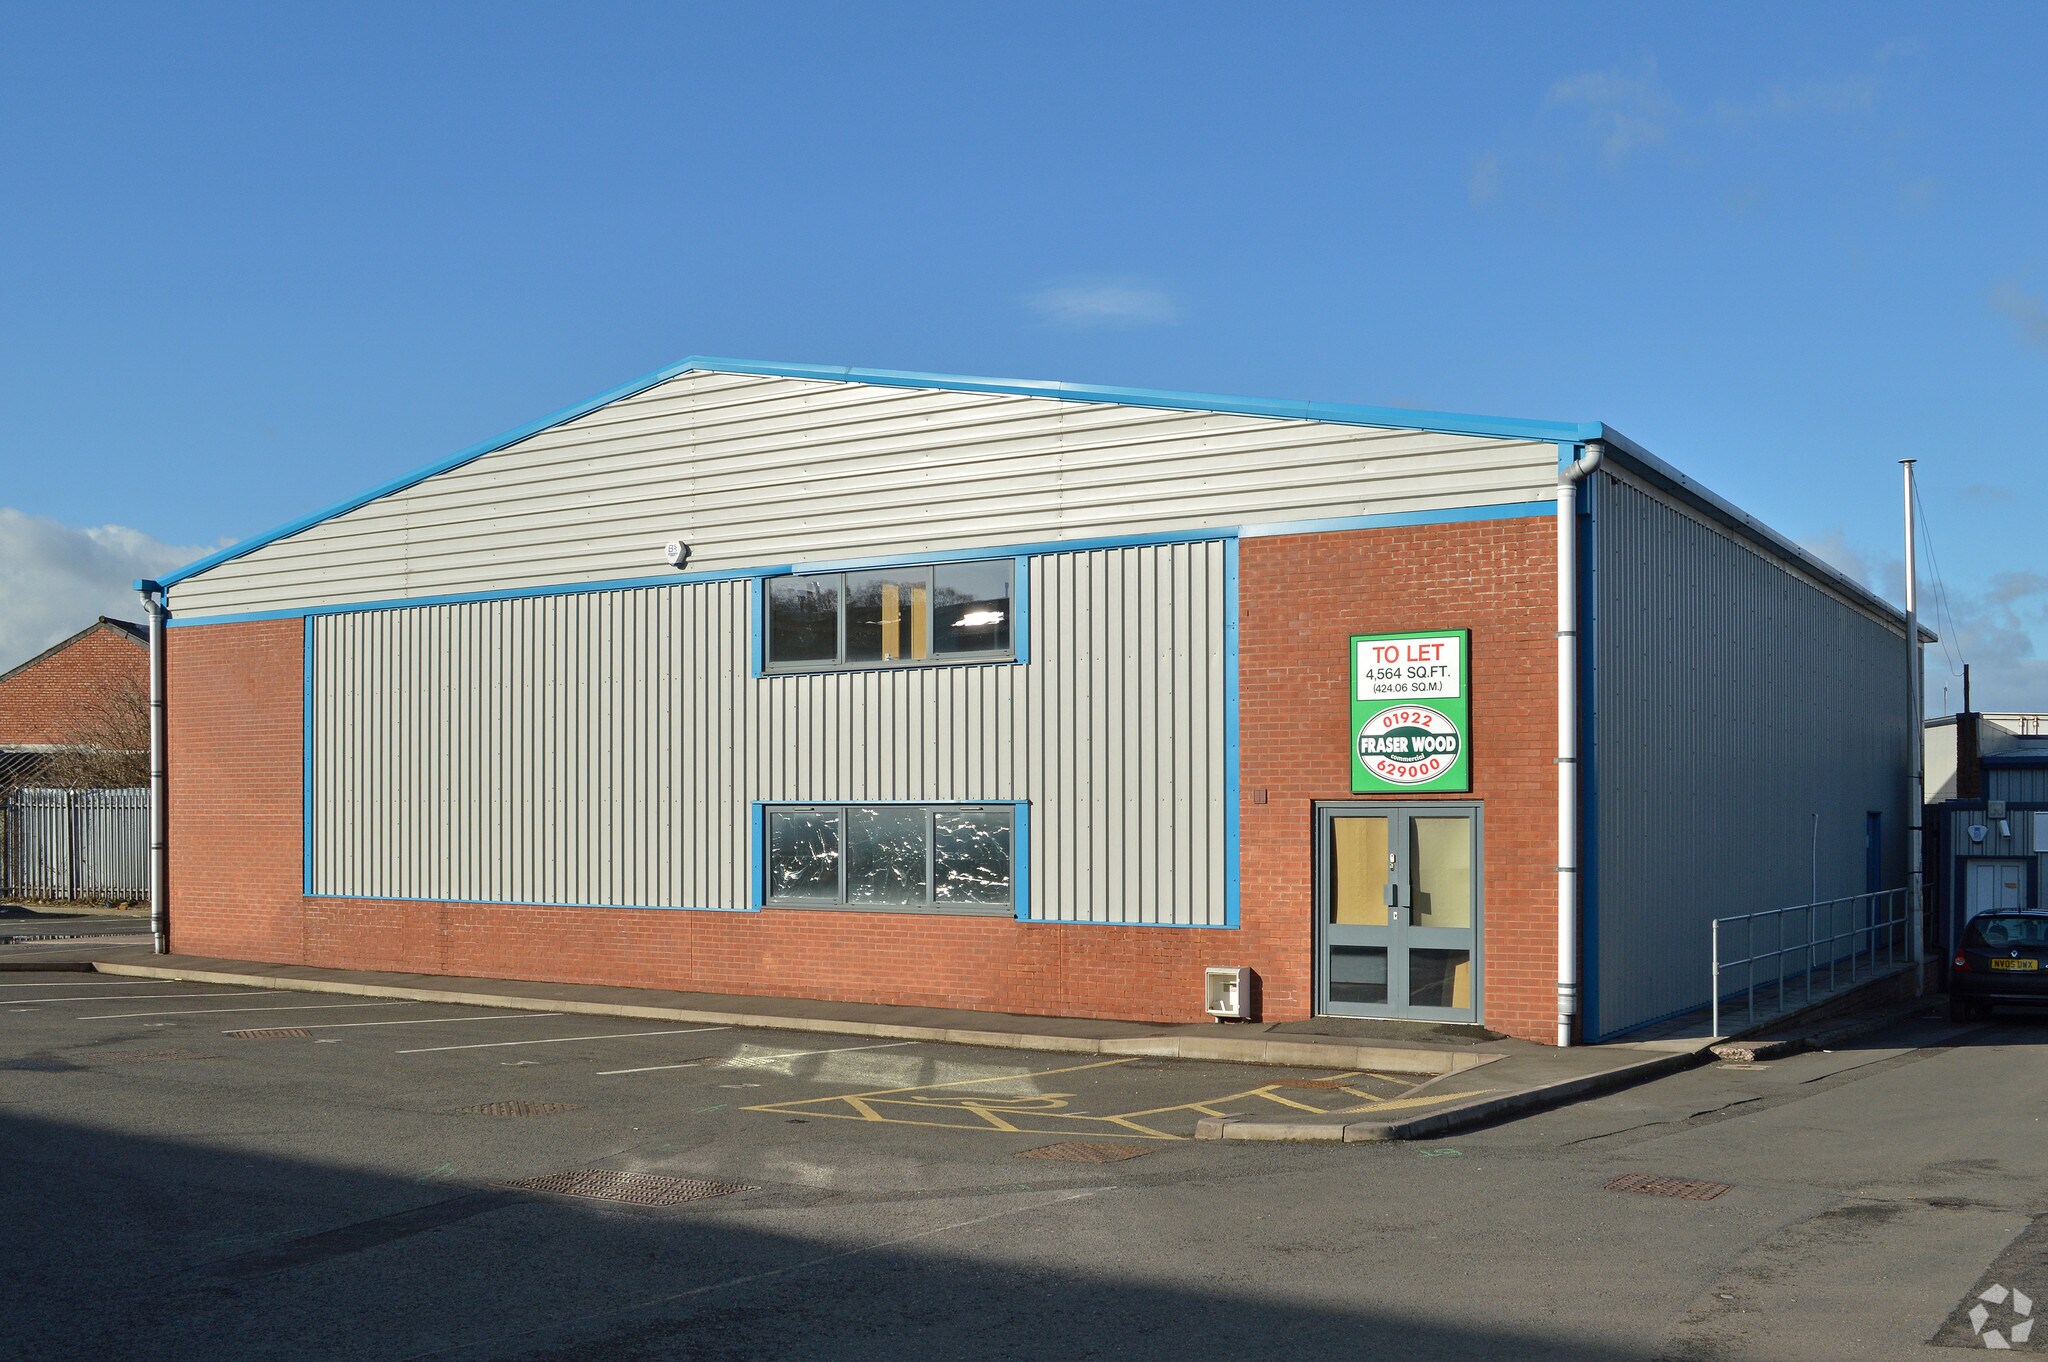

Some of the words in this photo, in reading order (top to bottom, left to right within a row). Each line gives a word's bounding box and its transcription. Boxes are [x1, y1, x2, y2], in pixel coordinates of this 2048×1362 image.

[1372, 646, 1399, 664] TO
[1407, 643, 1445, 662] LET
[1366, 667, 1402, 681] 4,564
[1407, 665, 1451, 679] SQ.FT.
[1373, 683, 1408, 694] (424.06
[1411, 681, 1443, 692] SQ.M.)
[1383, 711, 1433, 728] 01922
[1361, 736, 1409, 753] FRASER
[1412, 735, 1457, 752] WOOD
[1390, 752, 1426, 762] commercial
[1377, 758, 1441, 778] 629000
